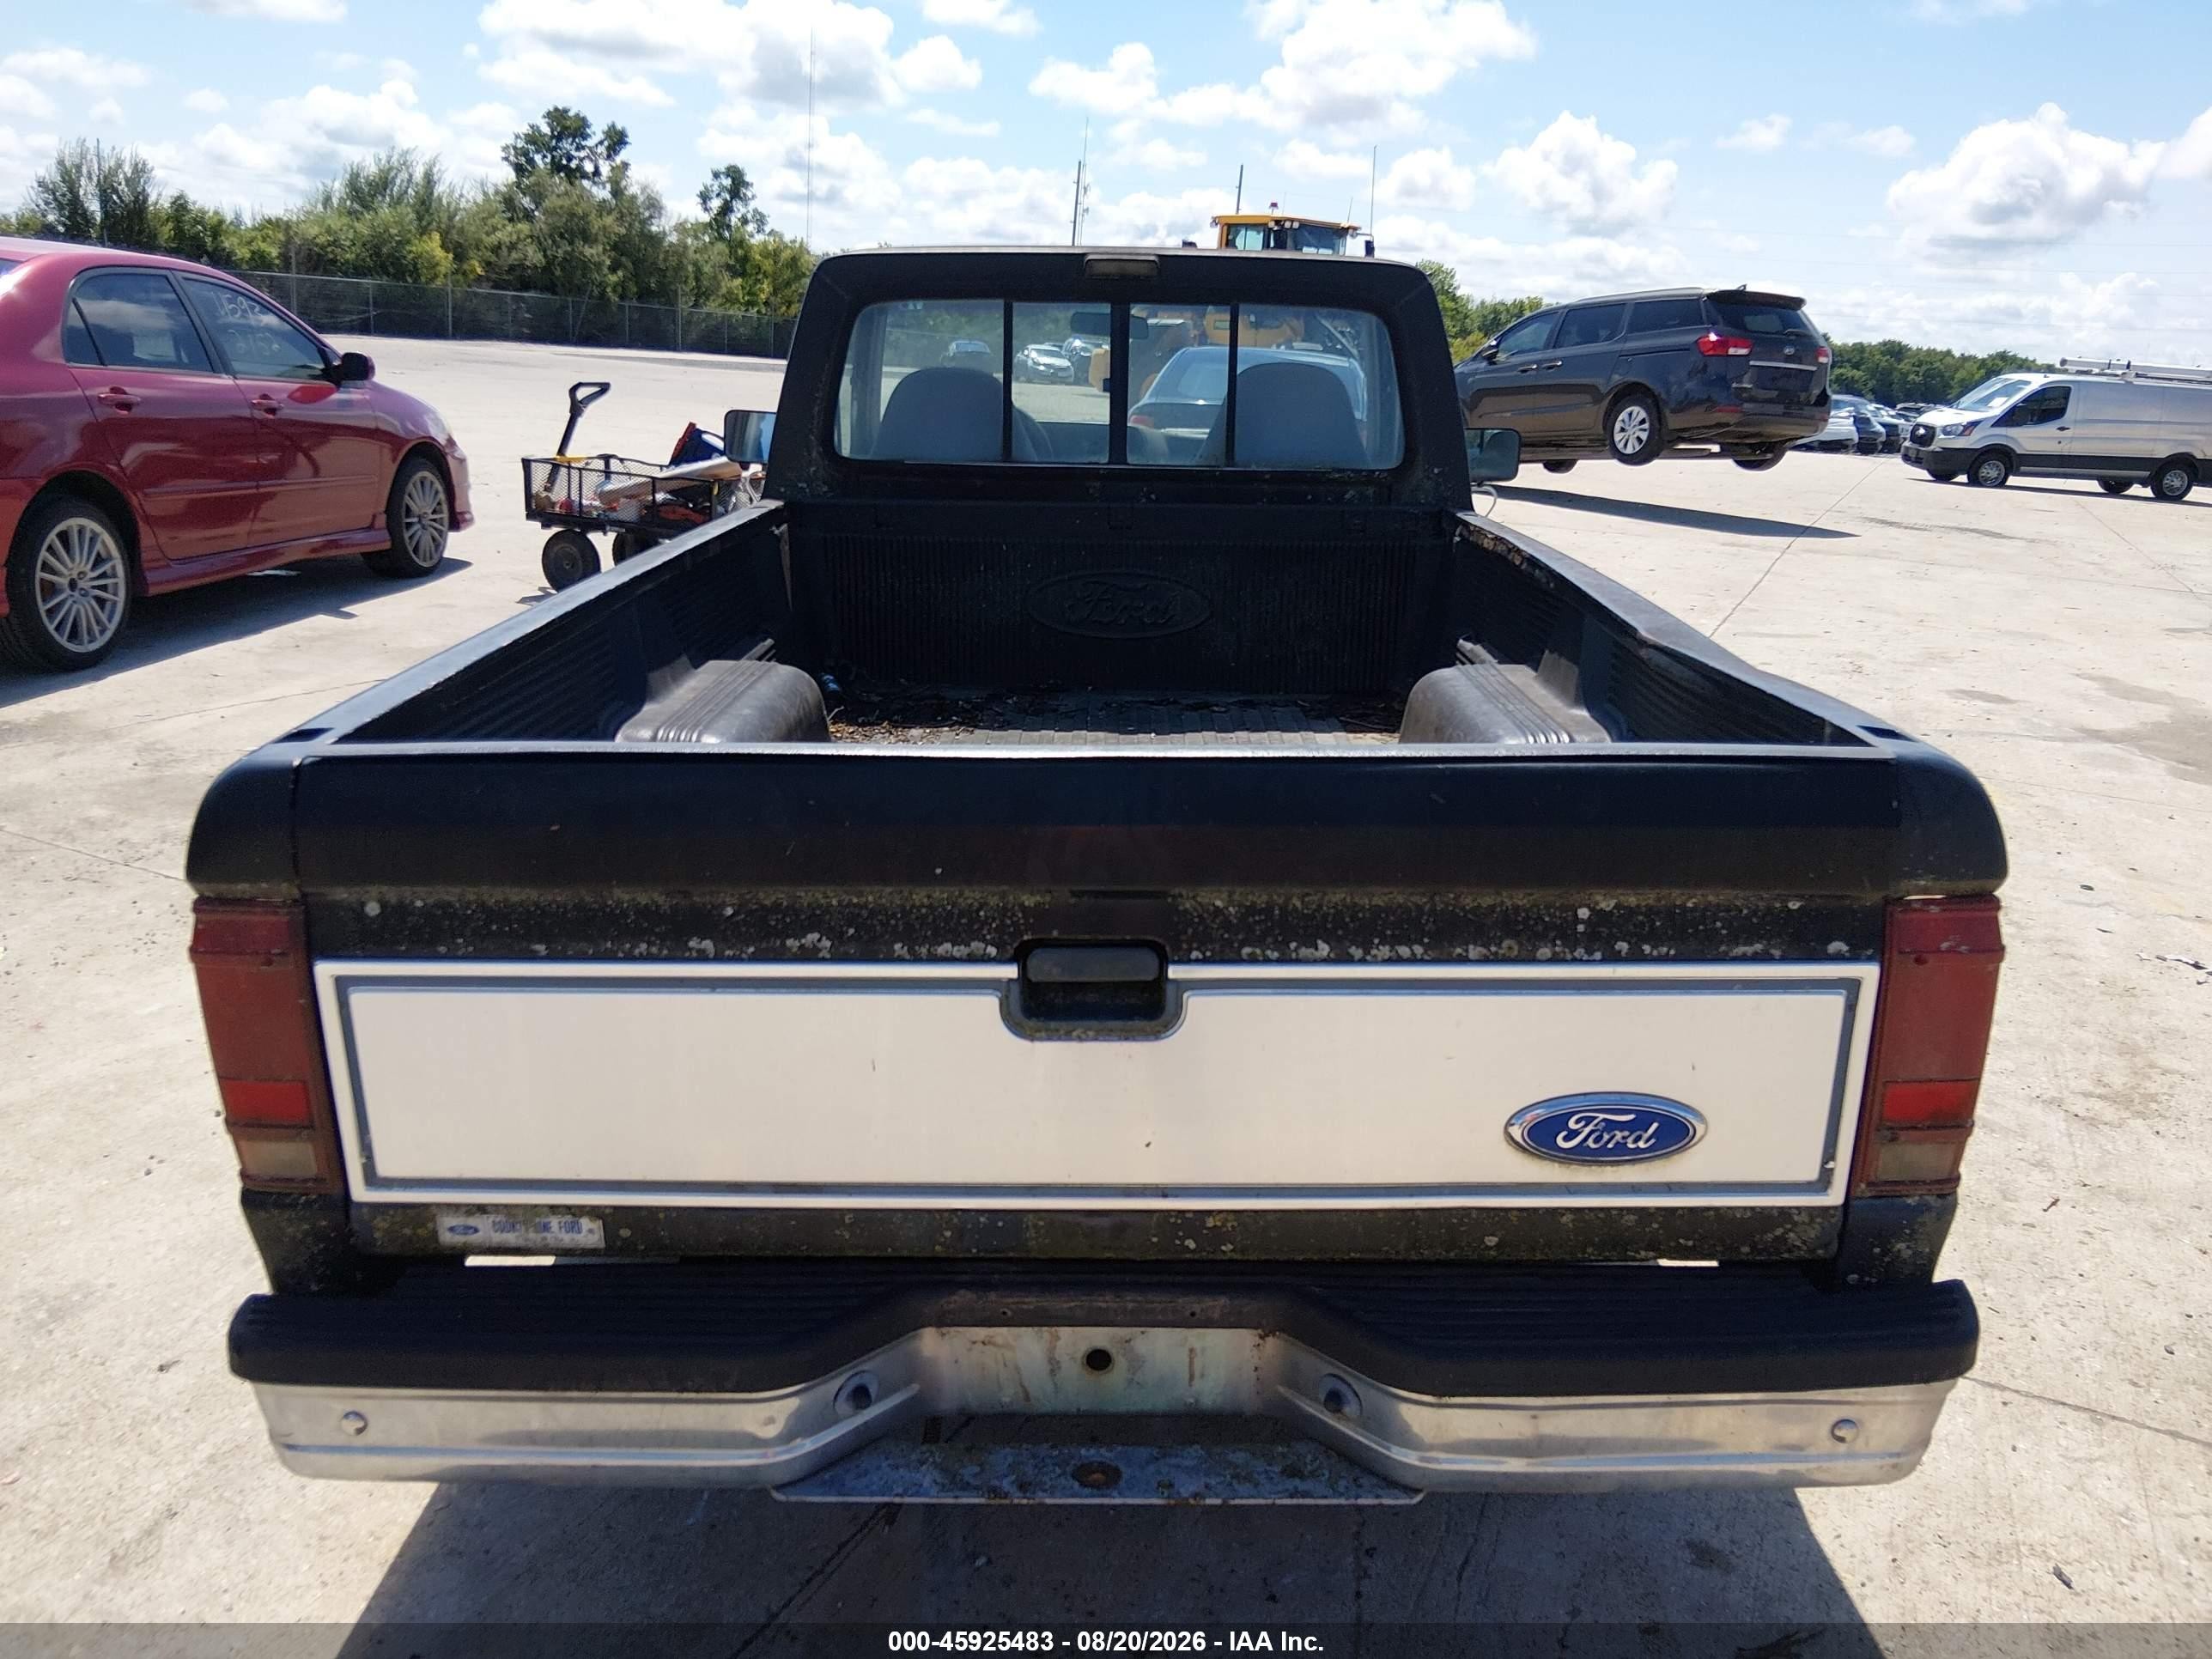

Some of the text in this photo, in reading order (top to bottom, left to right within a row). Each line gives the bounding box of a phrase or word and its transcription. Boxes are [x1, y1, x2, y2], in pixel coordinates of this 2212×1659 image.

[1065, 580, 1178, 626] Ford
[1555, 1112, 1659, 1150] Ford
[558, 1218, 584, 1235] FORD
